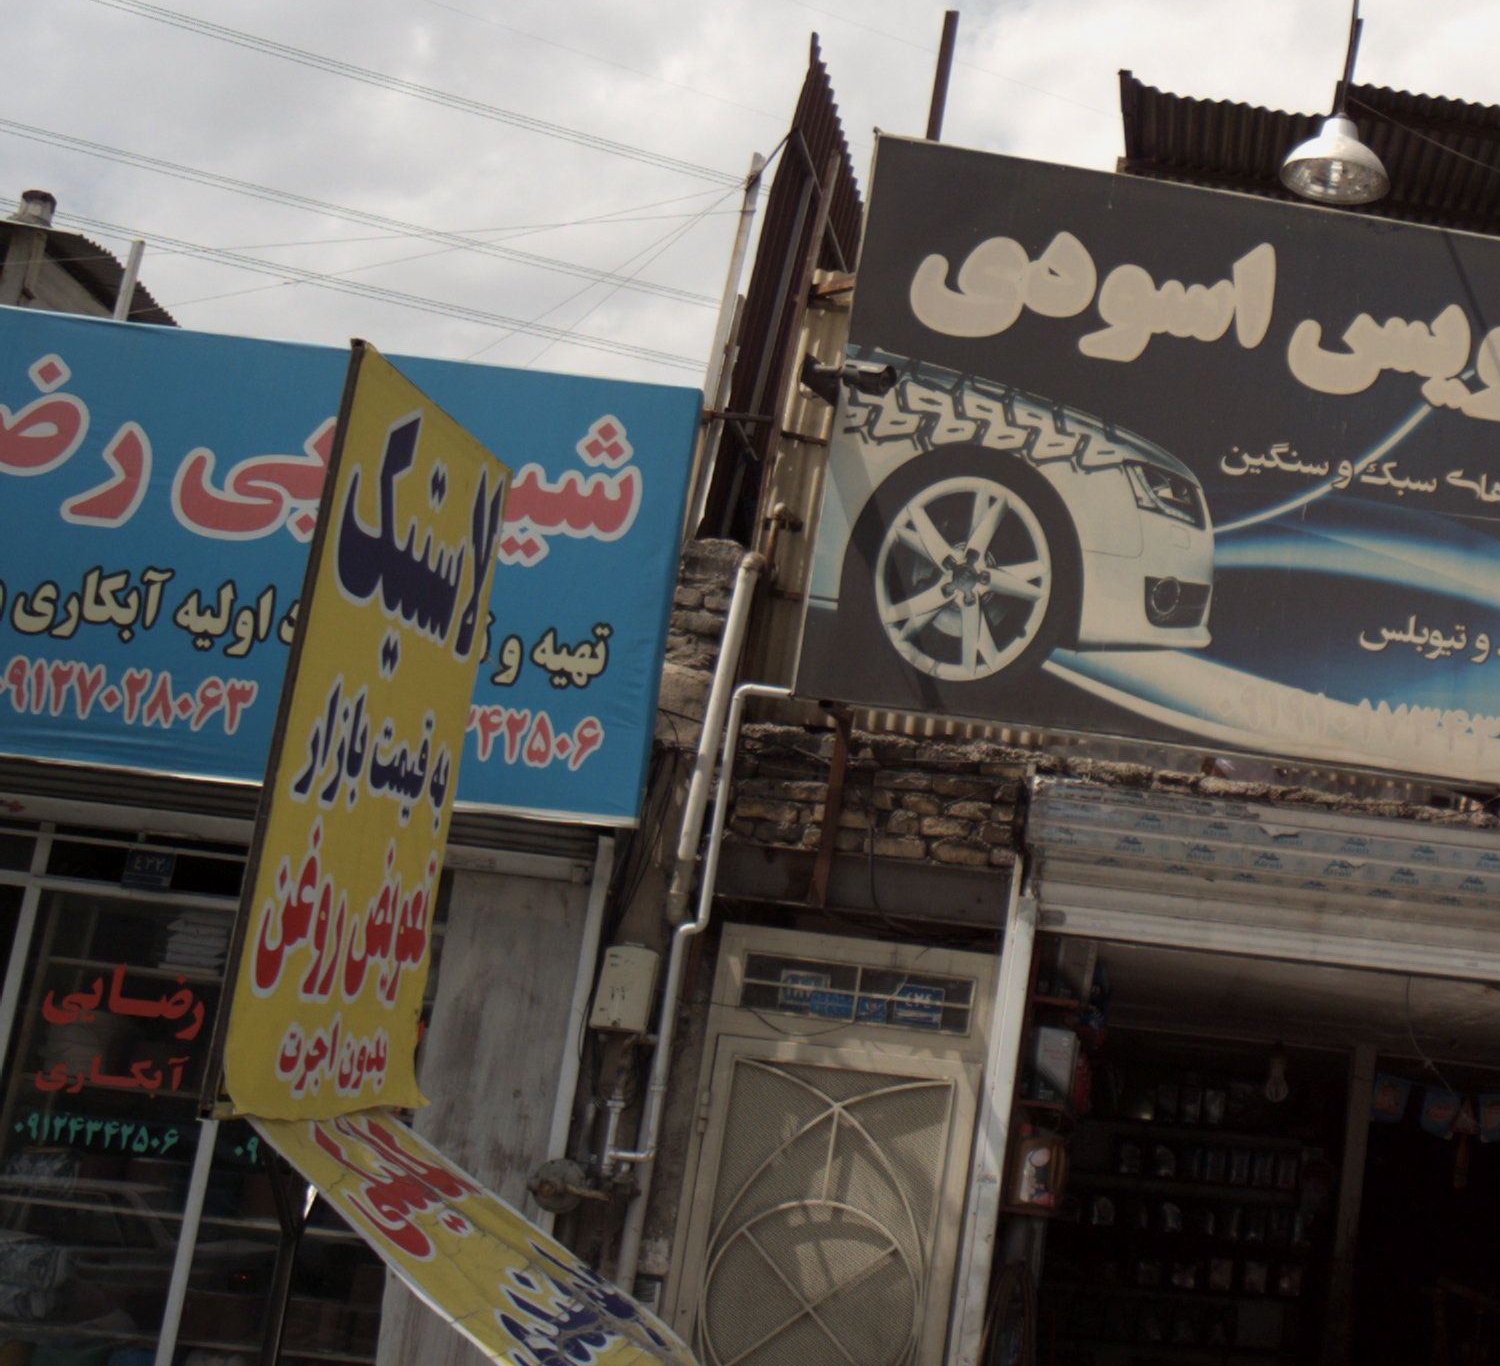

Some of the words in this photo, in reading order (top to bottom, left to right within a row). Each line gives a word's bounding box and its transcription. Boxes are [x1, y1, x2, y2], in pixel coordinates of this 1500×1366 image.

[1220, 442, 1330, 477] سنگین
[1331, 459, 1355, 488] و
[1359, 460, 1438, 496] سبک
[338, 413, 506, 681] لاستیک
[11, 565, 175, 643] آبکاری
[173, 579, 277, 658] اولیه
[1358, 614, 1468, 660] تیوبلس
[490, 634, 524, 686] و
[530, 621, 614, 689] تهیه
[1470, 633, 1491, 663] و
[0, 655, 258, 735] ۹۱۲۷۰۲۸۰۶۳
[292, 680, 369, 805] بازار
[255, 824, 346, 996] روغن
[343, 843, 439, 1003] تعویض
[41, 962, 205, 1040] رضایی
[34, 1055, 190, 1098] آبکاری
[278, 1019, 341, 1092] اجرت
[337, 1033, 388, 1092] بدون
